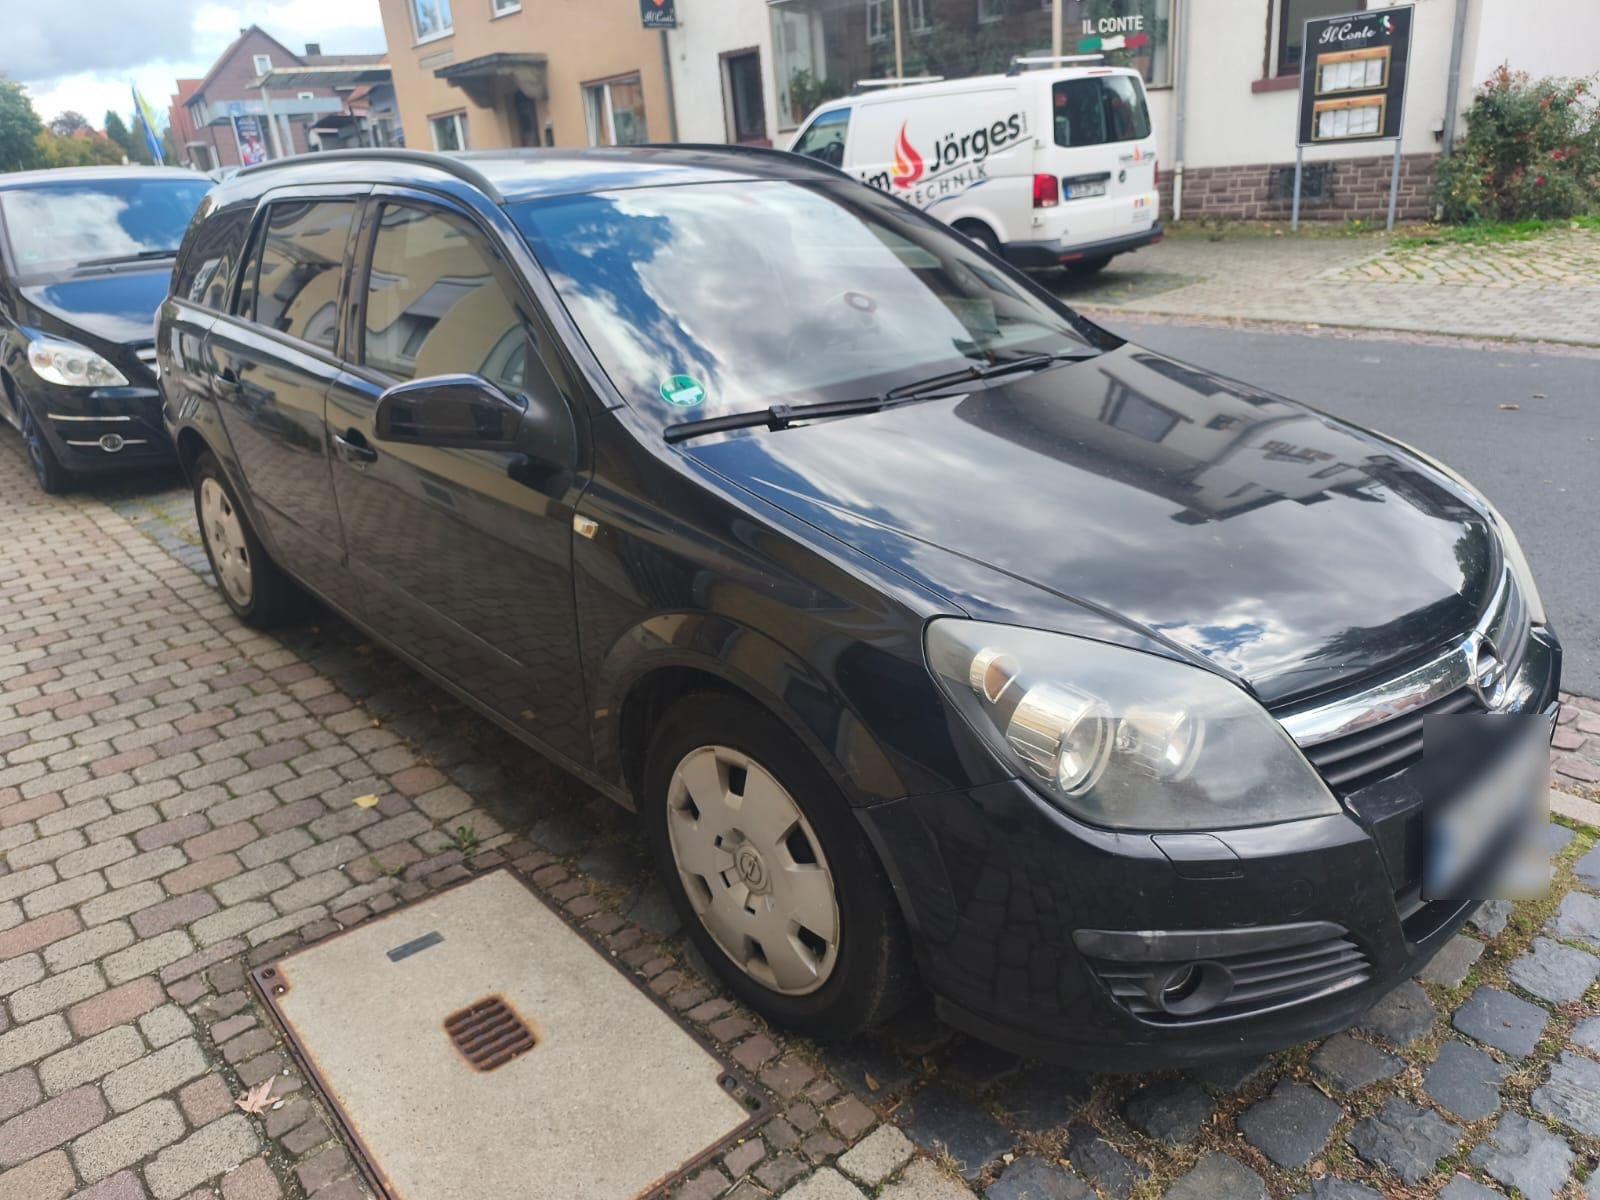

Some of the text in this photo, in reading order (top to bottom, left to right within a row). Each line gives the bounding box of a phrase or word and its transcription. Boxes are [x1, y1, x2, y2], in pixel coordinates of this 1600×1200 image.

[1082, 14, 1144, 35] IL CONTE
[1318, 22, 1377, 44] Il Conte
[930, 113, 1020, 172] Jörges
